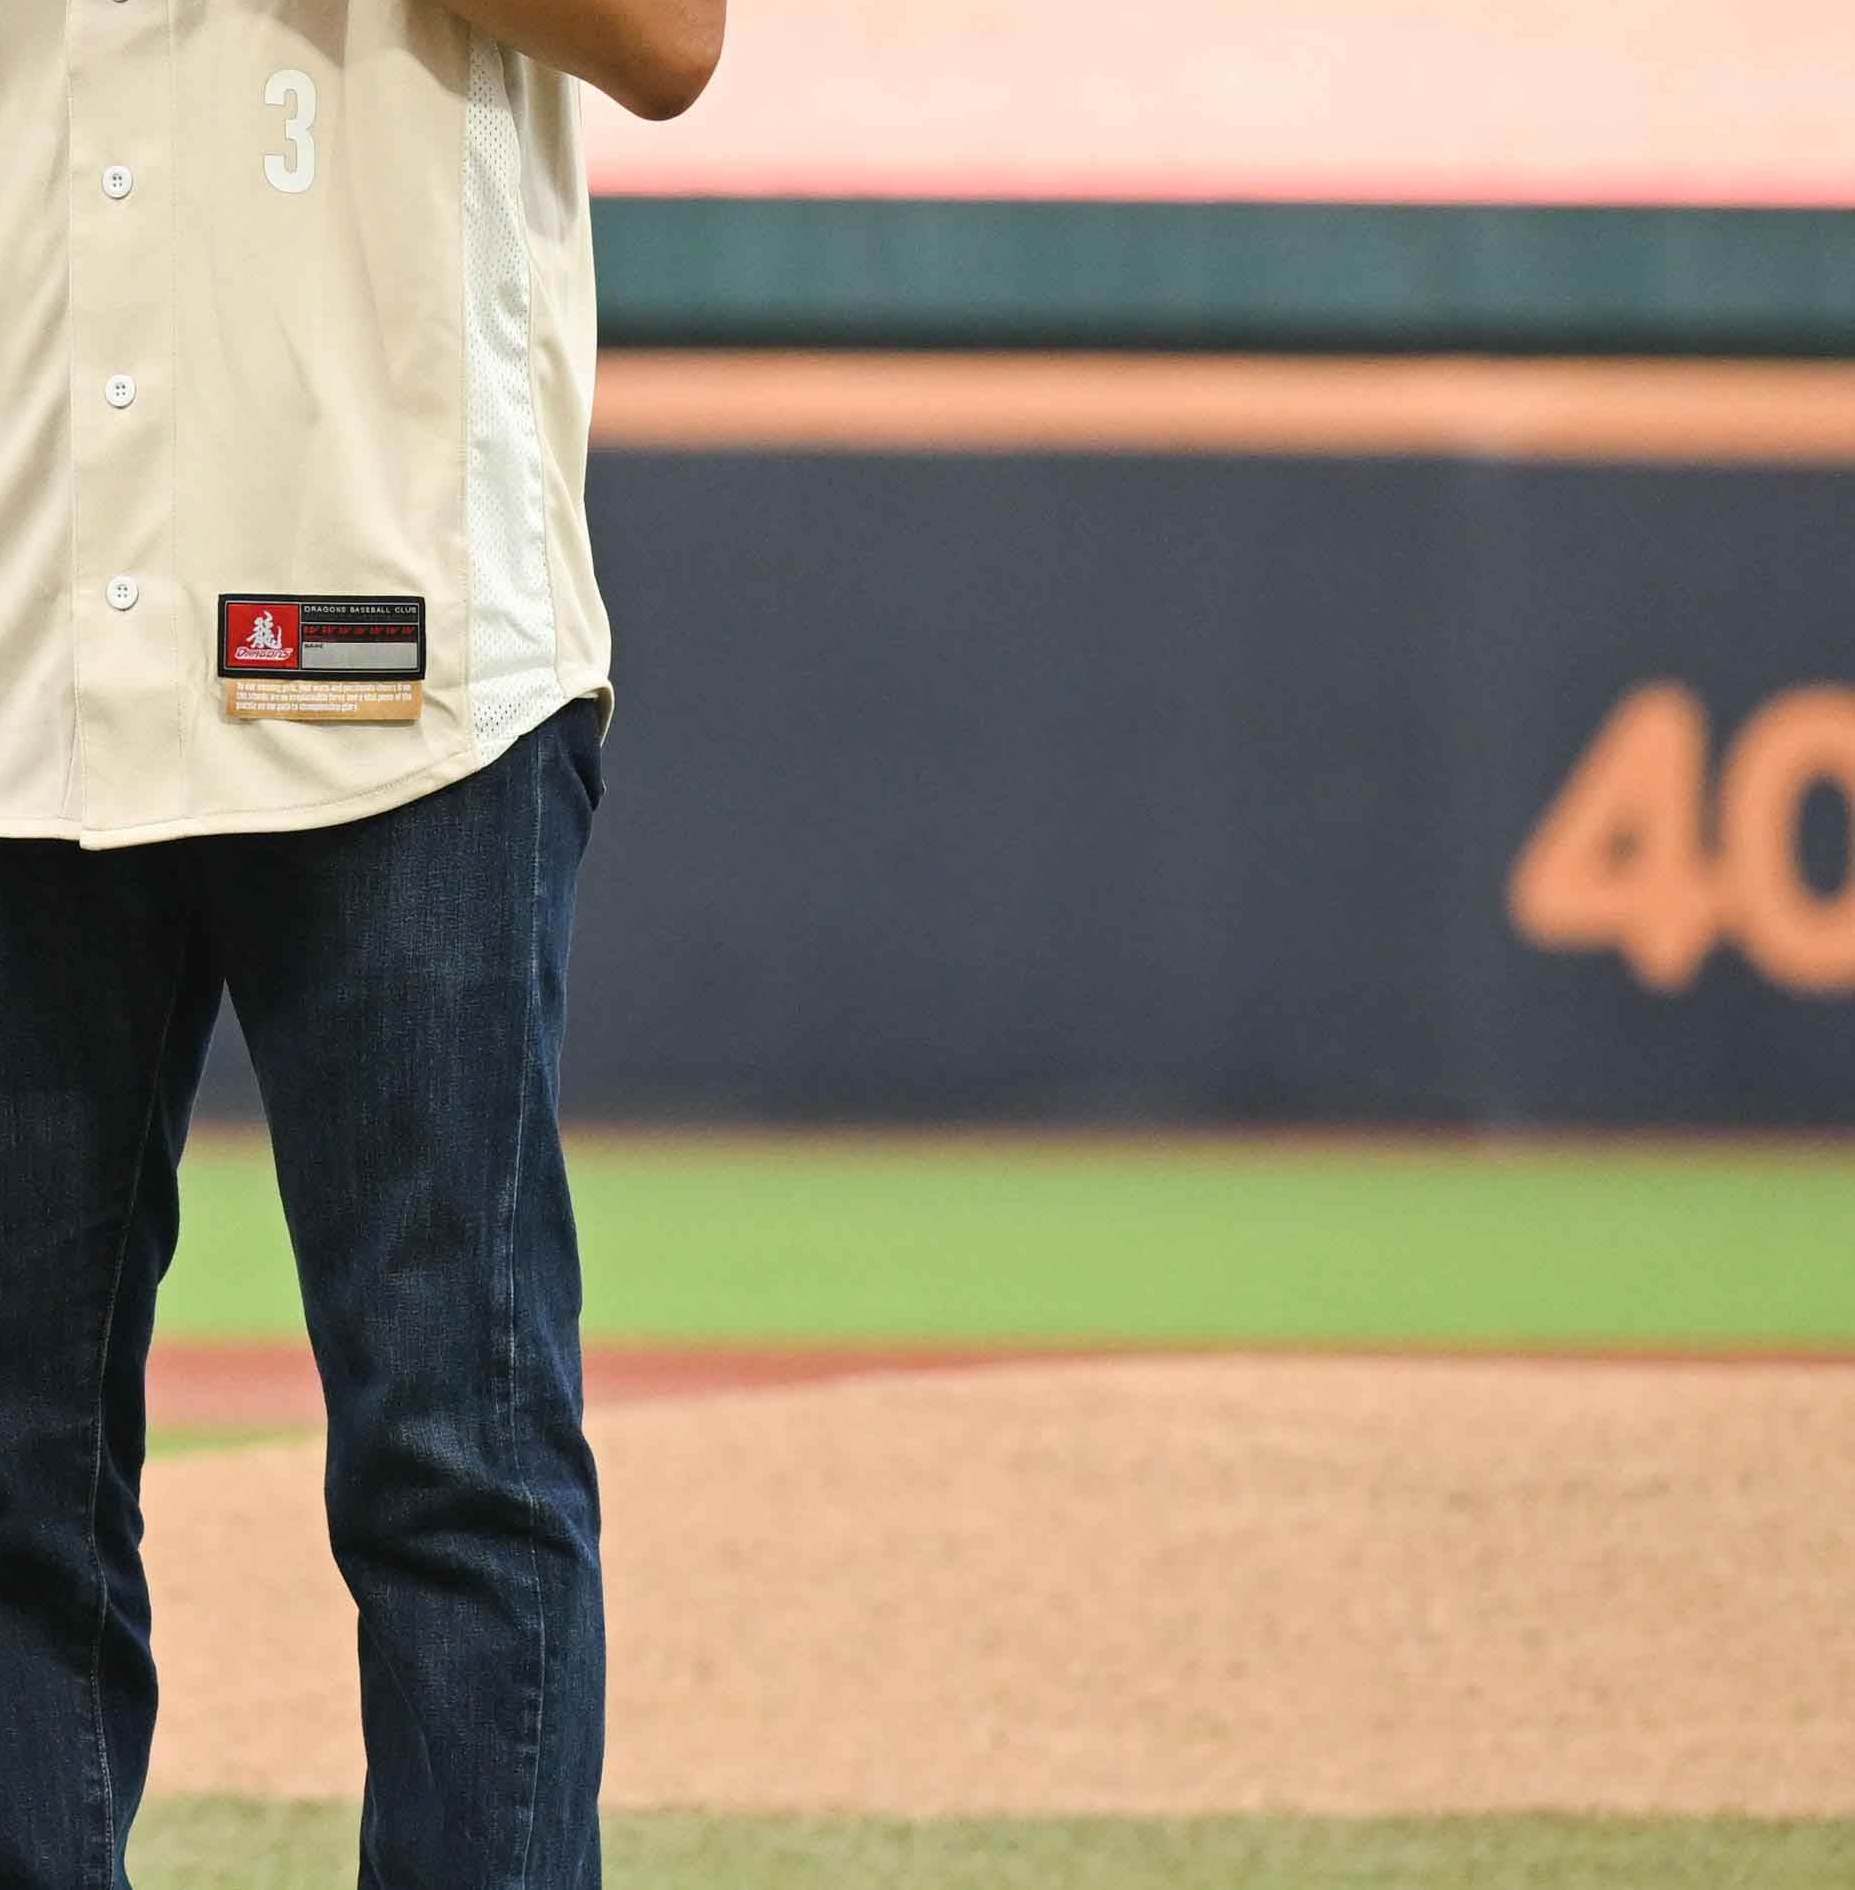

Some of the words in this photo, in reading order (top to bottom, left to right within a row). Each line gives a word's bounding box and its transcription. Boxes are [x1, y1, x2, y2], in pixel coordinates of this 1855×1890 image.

[263, 69, 316, 192] 3
[304, 605, 347, 613] DRAGONS
[350, 606, 390, 614] BASEBALL
[394, 606, 417, 614] CLUB
